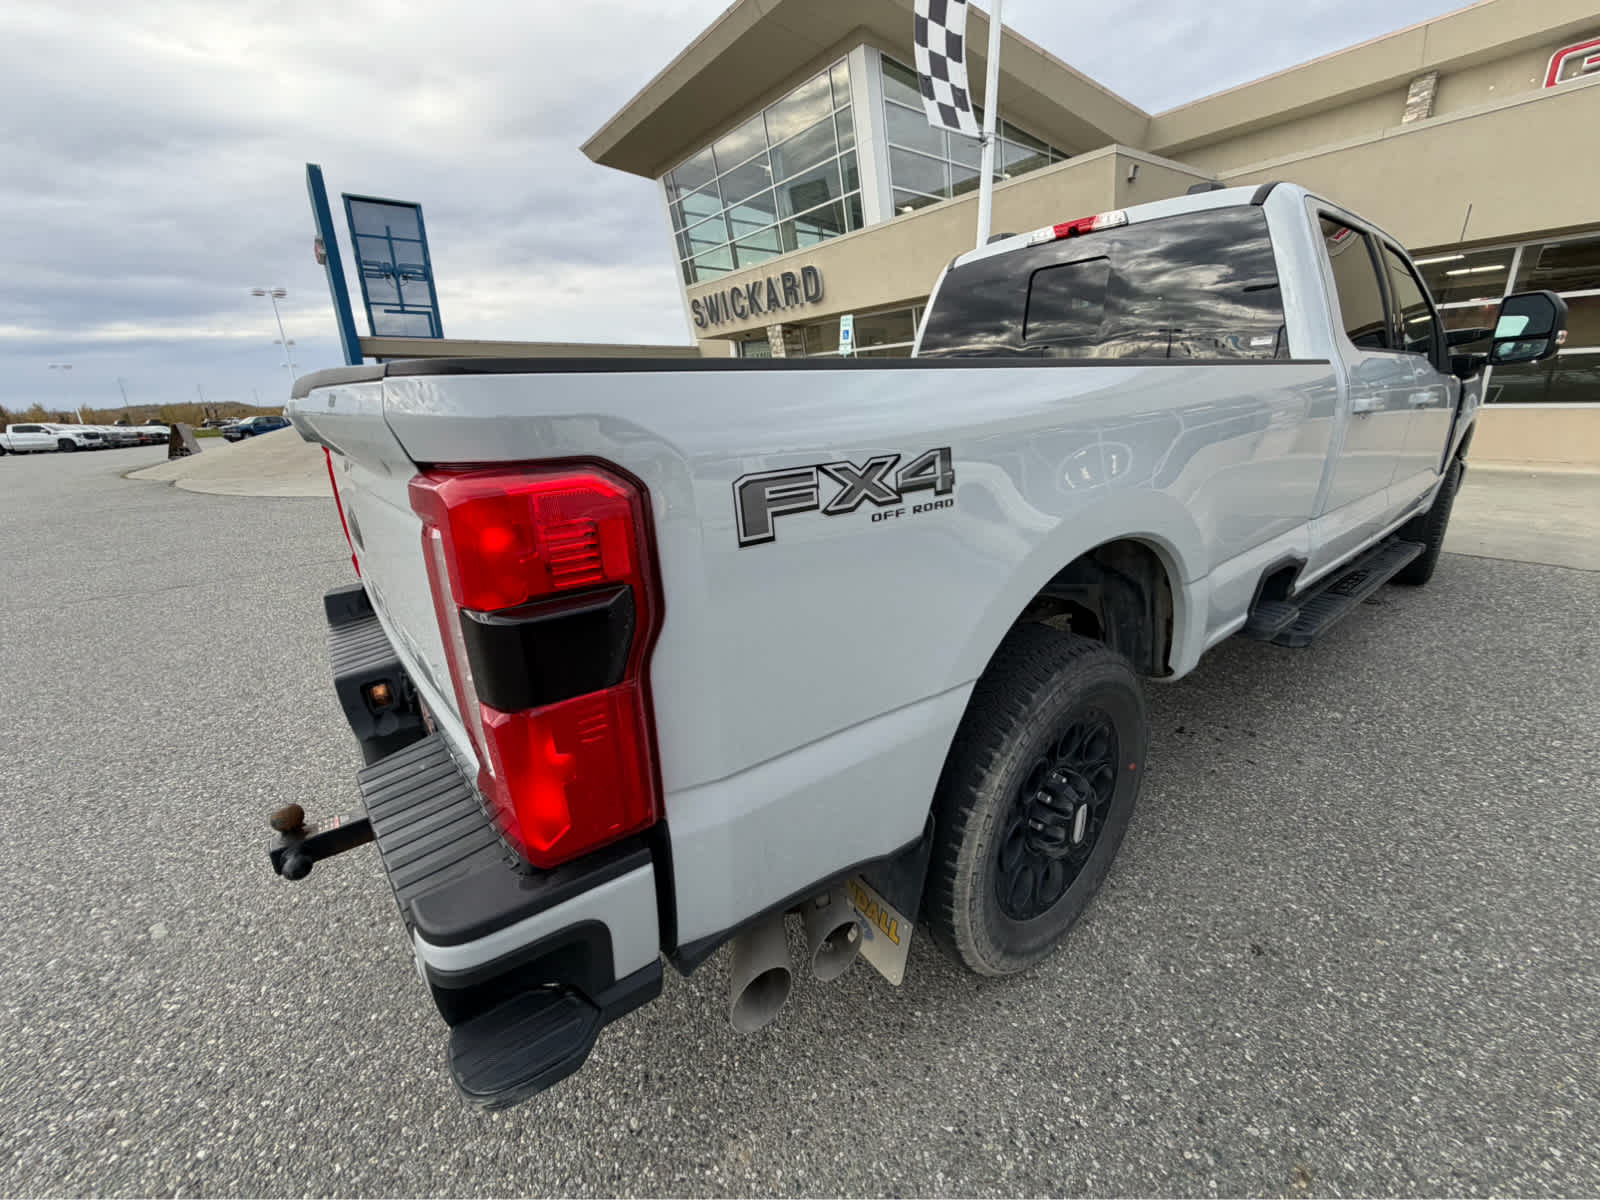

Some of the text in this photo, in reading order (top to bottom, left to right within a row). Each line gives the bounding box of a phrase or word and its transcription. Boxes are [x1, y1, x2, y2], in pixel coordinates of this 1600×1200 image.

[691, 265, 823, 329] SWICKARD
[732, 446, 955, 548] FX4
[871, 498, 954, 523] OFF ROAD
